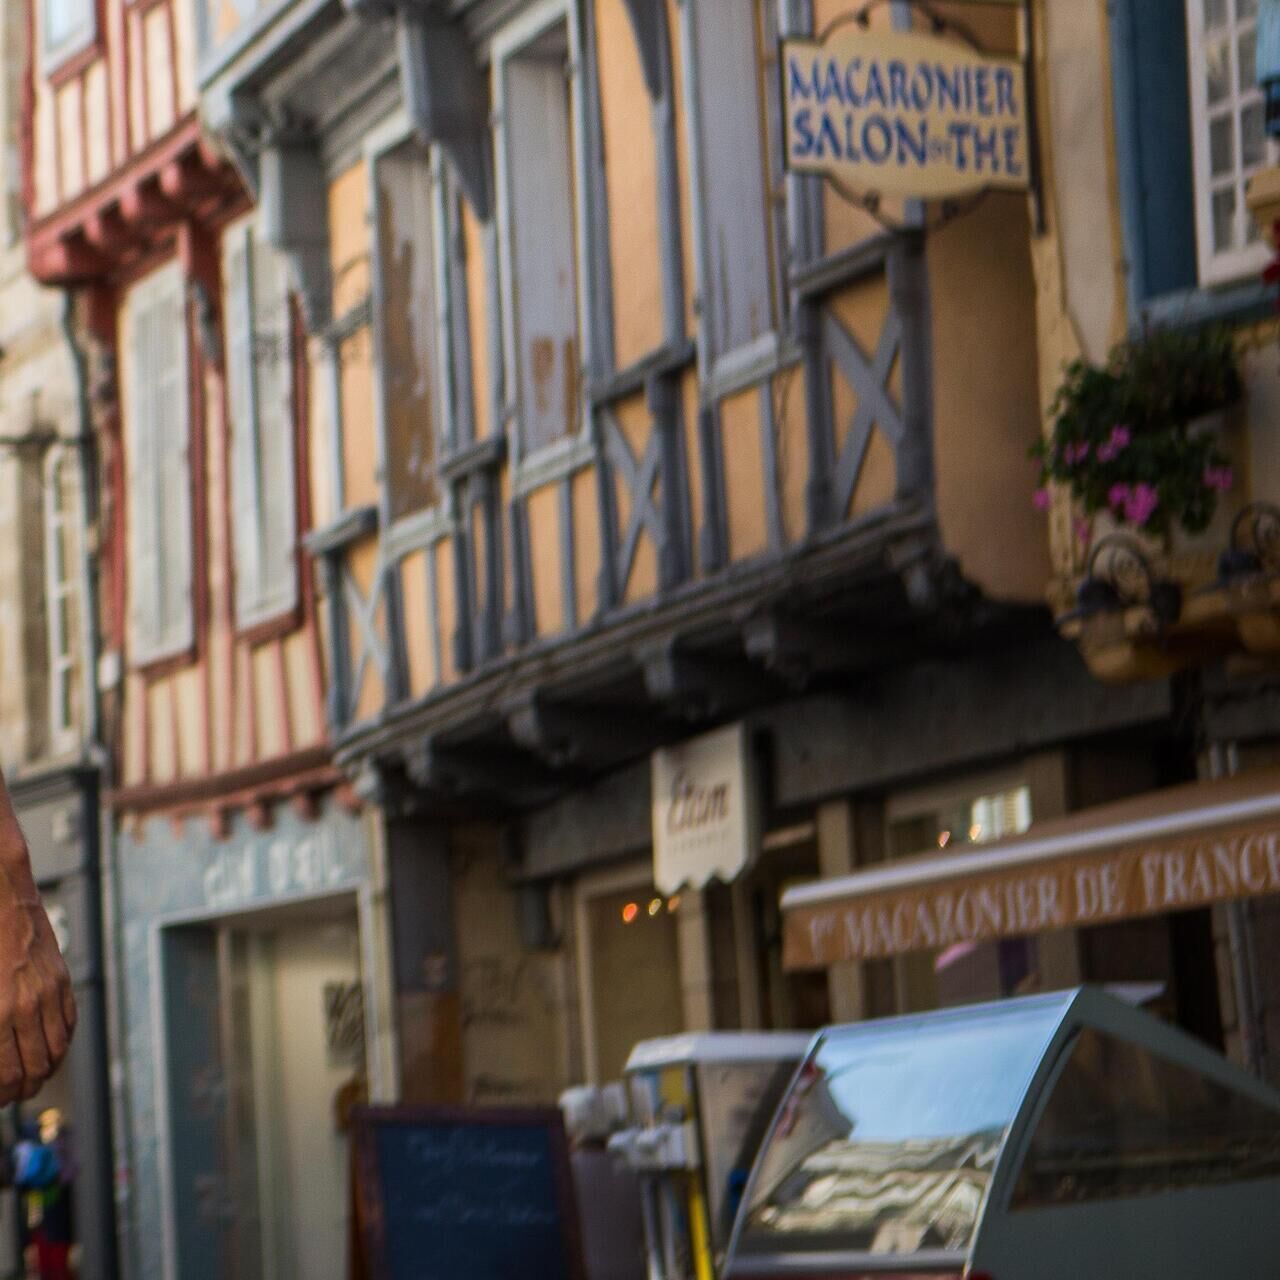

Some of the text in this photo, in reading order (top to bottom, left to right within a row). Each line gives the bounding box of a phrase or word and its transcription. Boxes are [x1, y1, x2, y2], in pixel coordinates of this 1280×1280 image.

[790, 55, 1017, 117] MACARONIER
[792, 107, 928, 166] SALON
[843, 875, 1065, 960] MACARONIER
[1074, 860, 1127, 919] DE
